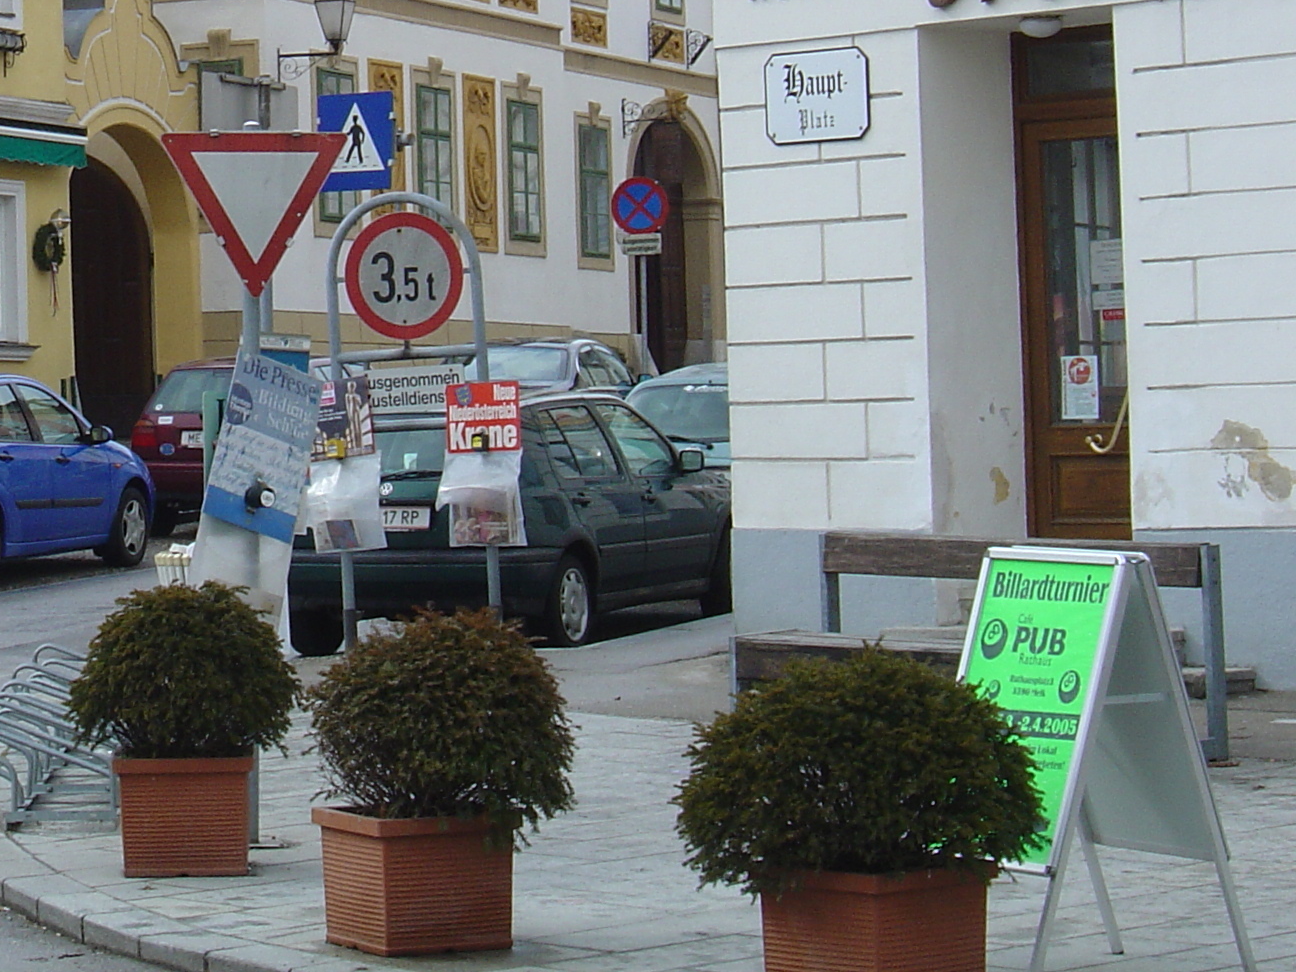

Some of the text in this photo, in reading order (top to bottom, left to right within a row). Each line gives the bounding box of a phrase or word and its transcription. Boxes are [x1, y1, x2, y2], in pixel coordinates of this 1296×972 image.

[783, 63, 848, 103] Haupt-
[798, 109, 835, 136] Platz
[371, 251, 436, 304] 3,5 t
[243, 356, 269, 381] Die
[270, 366, 317, 398] Presse
[368, 372, 460, 392] usgenommen
[371, 391, 445, 408] ustelldiens
[493, 384, 516, 401] Neue
[401, 511, 419, 524] RP
[992, 571, 1110, 604] Billardturnier
[1012, 626, 1067, 655] PUB
